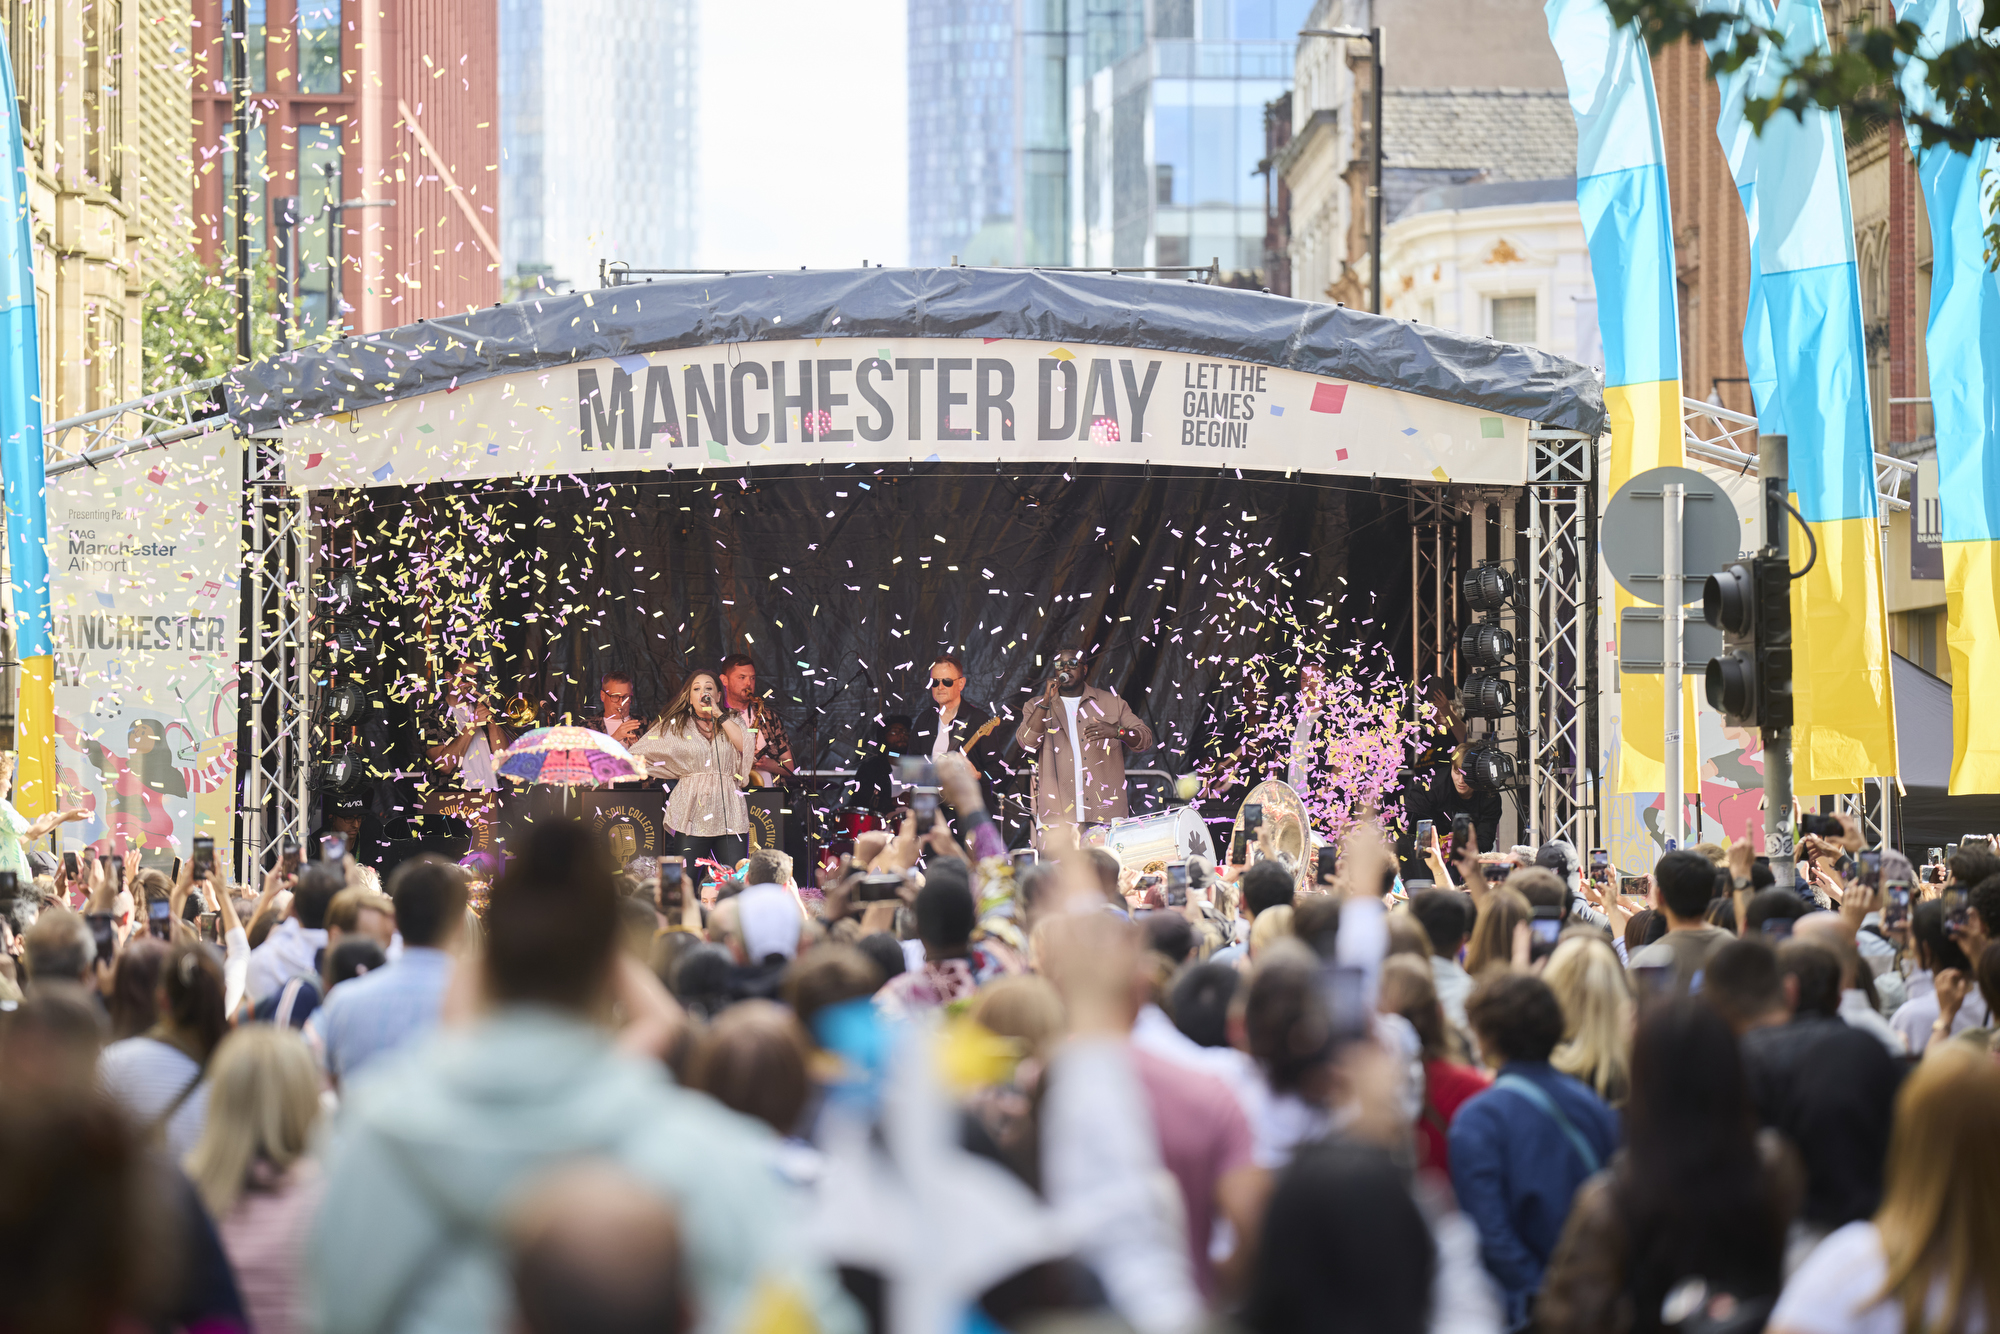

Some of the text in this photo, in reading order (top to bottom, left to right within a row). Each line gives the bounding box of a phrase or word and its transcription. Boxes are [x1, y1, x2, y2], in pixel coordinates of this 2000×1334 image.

[1185, 362, 1267, 392] LET THE
[578, 357, 1162, 451] MANCHESTER DAY
[1183, 391, 1255, 420] GAMES
[1181, 419, 1248, 448] BEGIN!
[68, 509, 110, 522] Presenting
[69, 530, 96, 540] MAG
[69, 540, 177, 557] Manchester
[68, 557, 127, 575] Airport
[52, 615, 225, 652] ANCHESTER
[54, 652, 87, 687] AY
[439, 805, 490, 850] SOUL COLECTIVE
[605, 806, 627, 819] SOUL
[628, 806, 655, 851] COLLECTIVE
[750, 805, 776, 849] COLLECTIVE
